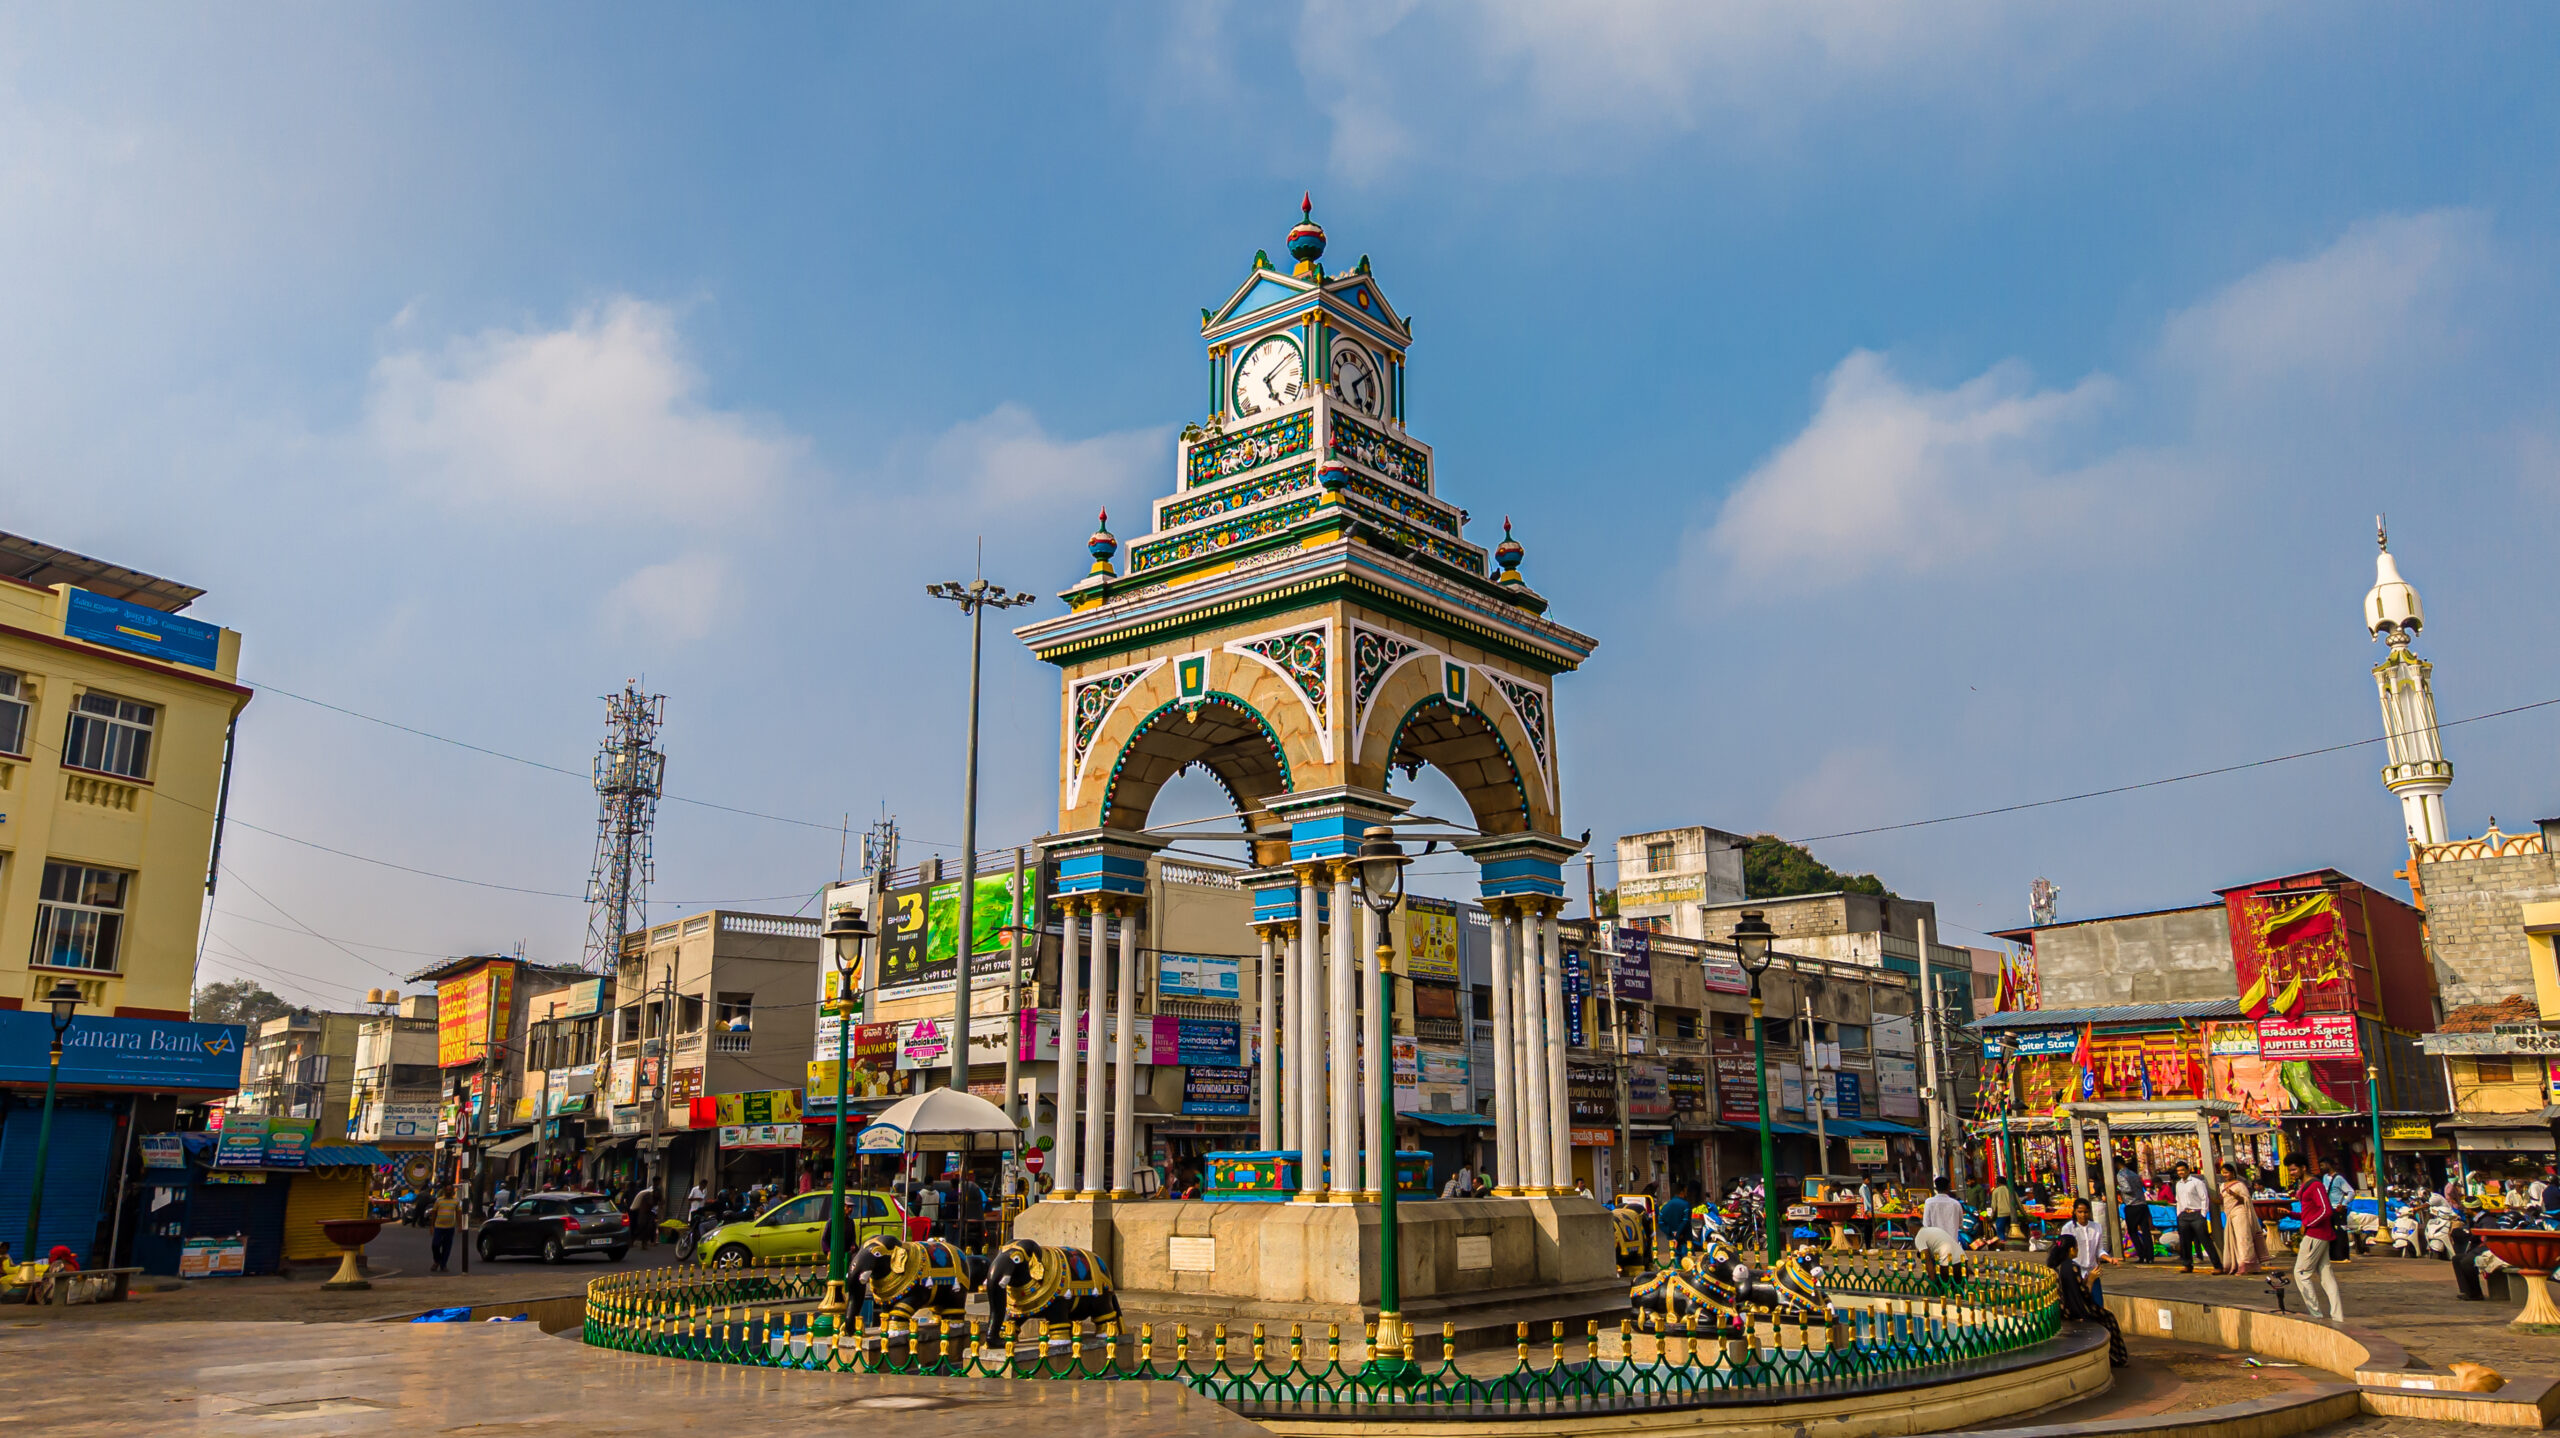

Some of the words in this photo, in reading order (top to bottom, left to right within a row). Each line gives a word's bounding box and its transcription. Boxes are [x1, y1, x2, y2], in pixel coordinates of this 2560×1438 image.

[887, 914, 911, 925] BHIMA
[1624, 979, 1646, 988] CENTRE
[61, 1023, 142, 1049] Canara
[150, 1029, 204, 1053] Bank
[904, 1036, 945, 1047] Mahalakshmi
[1220, 1037, 1236, 1047] Setty
[857, 1042, 888, 1055] BHAVANI
[1988, 1045, 2001, 1053] Ne
[2047, 1040, 2075, 1049] Store
[2263, 1040, 2307, 1050] JUPITER
[2310, 1039, 2355, 1049] STORES
[440, 1041, 465, 1064] MYSORE
[1233, 1085, 1250, 1095] SETTY
